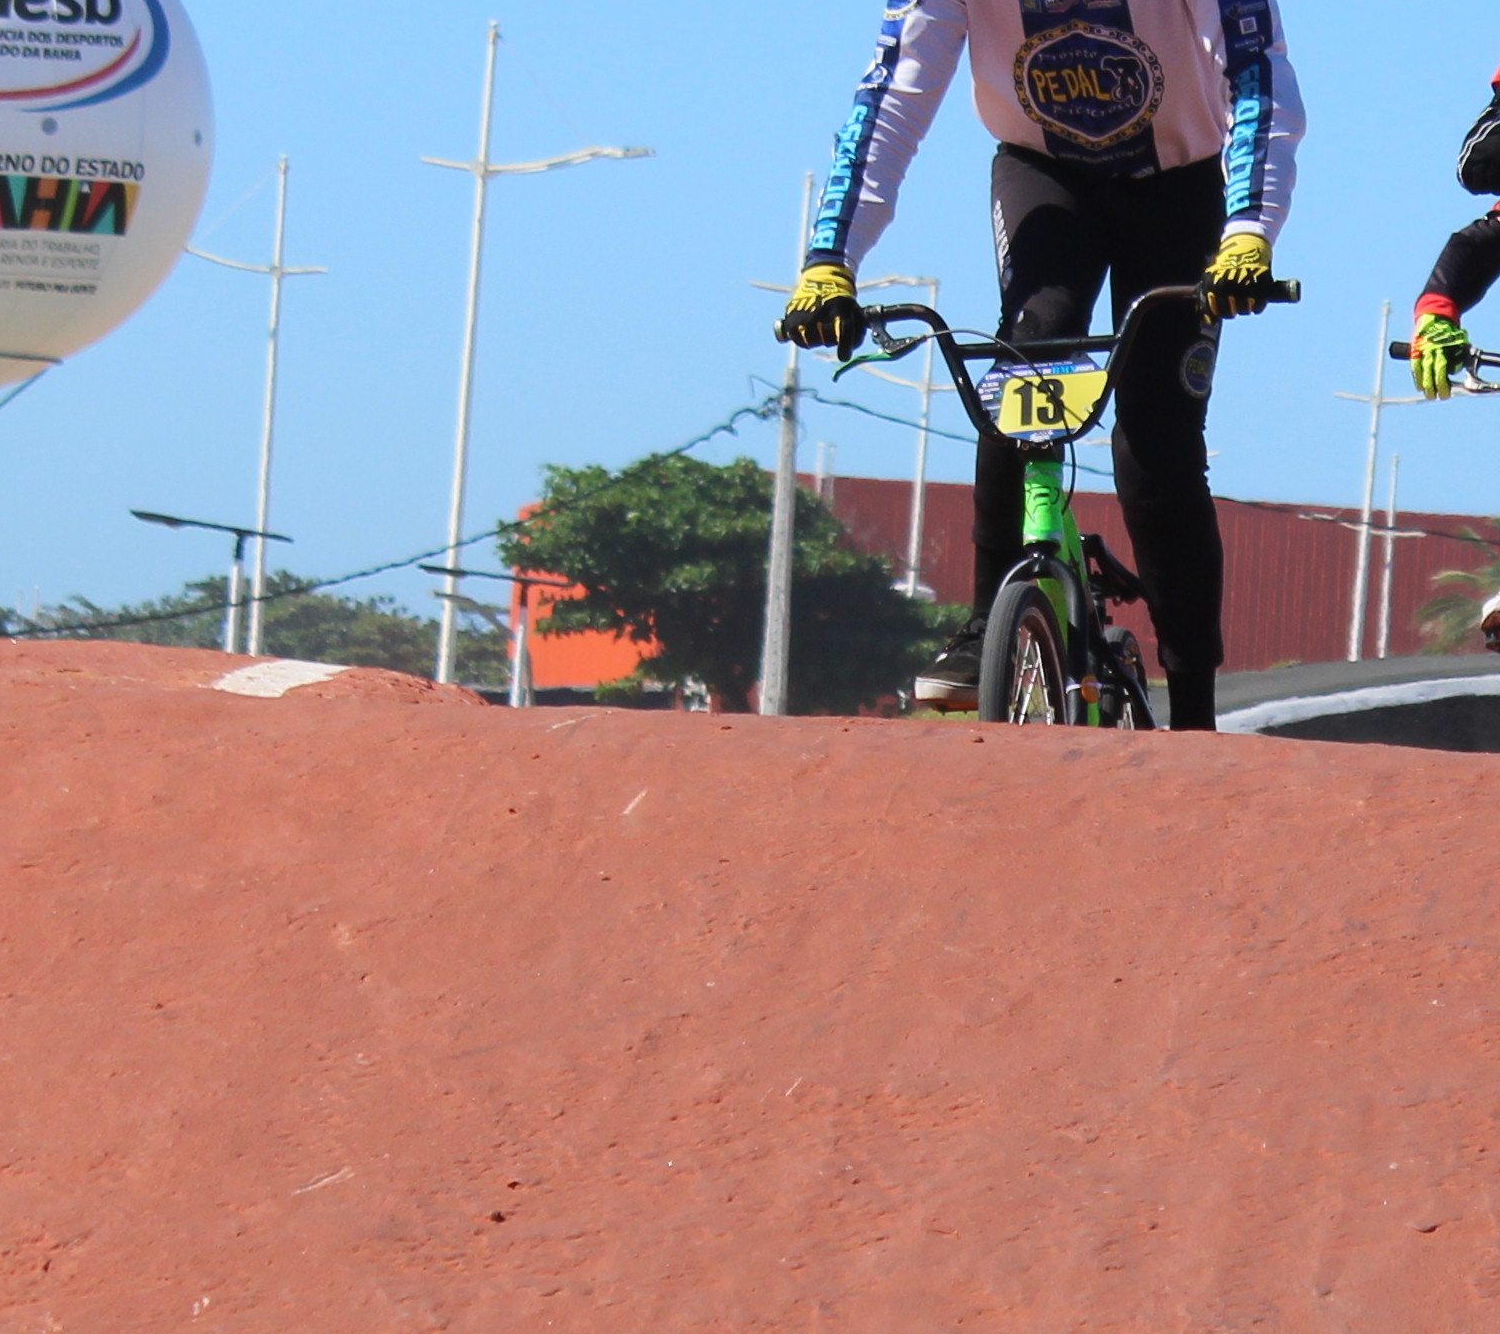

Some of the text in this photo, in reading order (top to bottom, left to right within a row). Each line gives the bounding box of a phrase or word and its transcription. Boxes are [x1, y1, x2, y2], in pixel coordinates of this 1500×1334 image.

[28, 30, 53, 44] DOS
[55, 31, 124, 48] DESPORTOS
[22, 46, 40, 59] DA
[43, 47, 82, 61] BAHIA
[1031, 64, 1113, 104] PEDAL
[41, 156, 70, 175] DO
[75, 157, 145, 181] ESTADO
[21, 239, 38, 251] DO
[1013, 378, 1065, 426] 13
